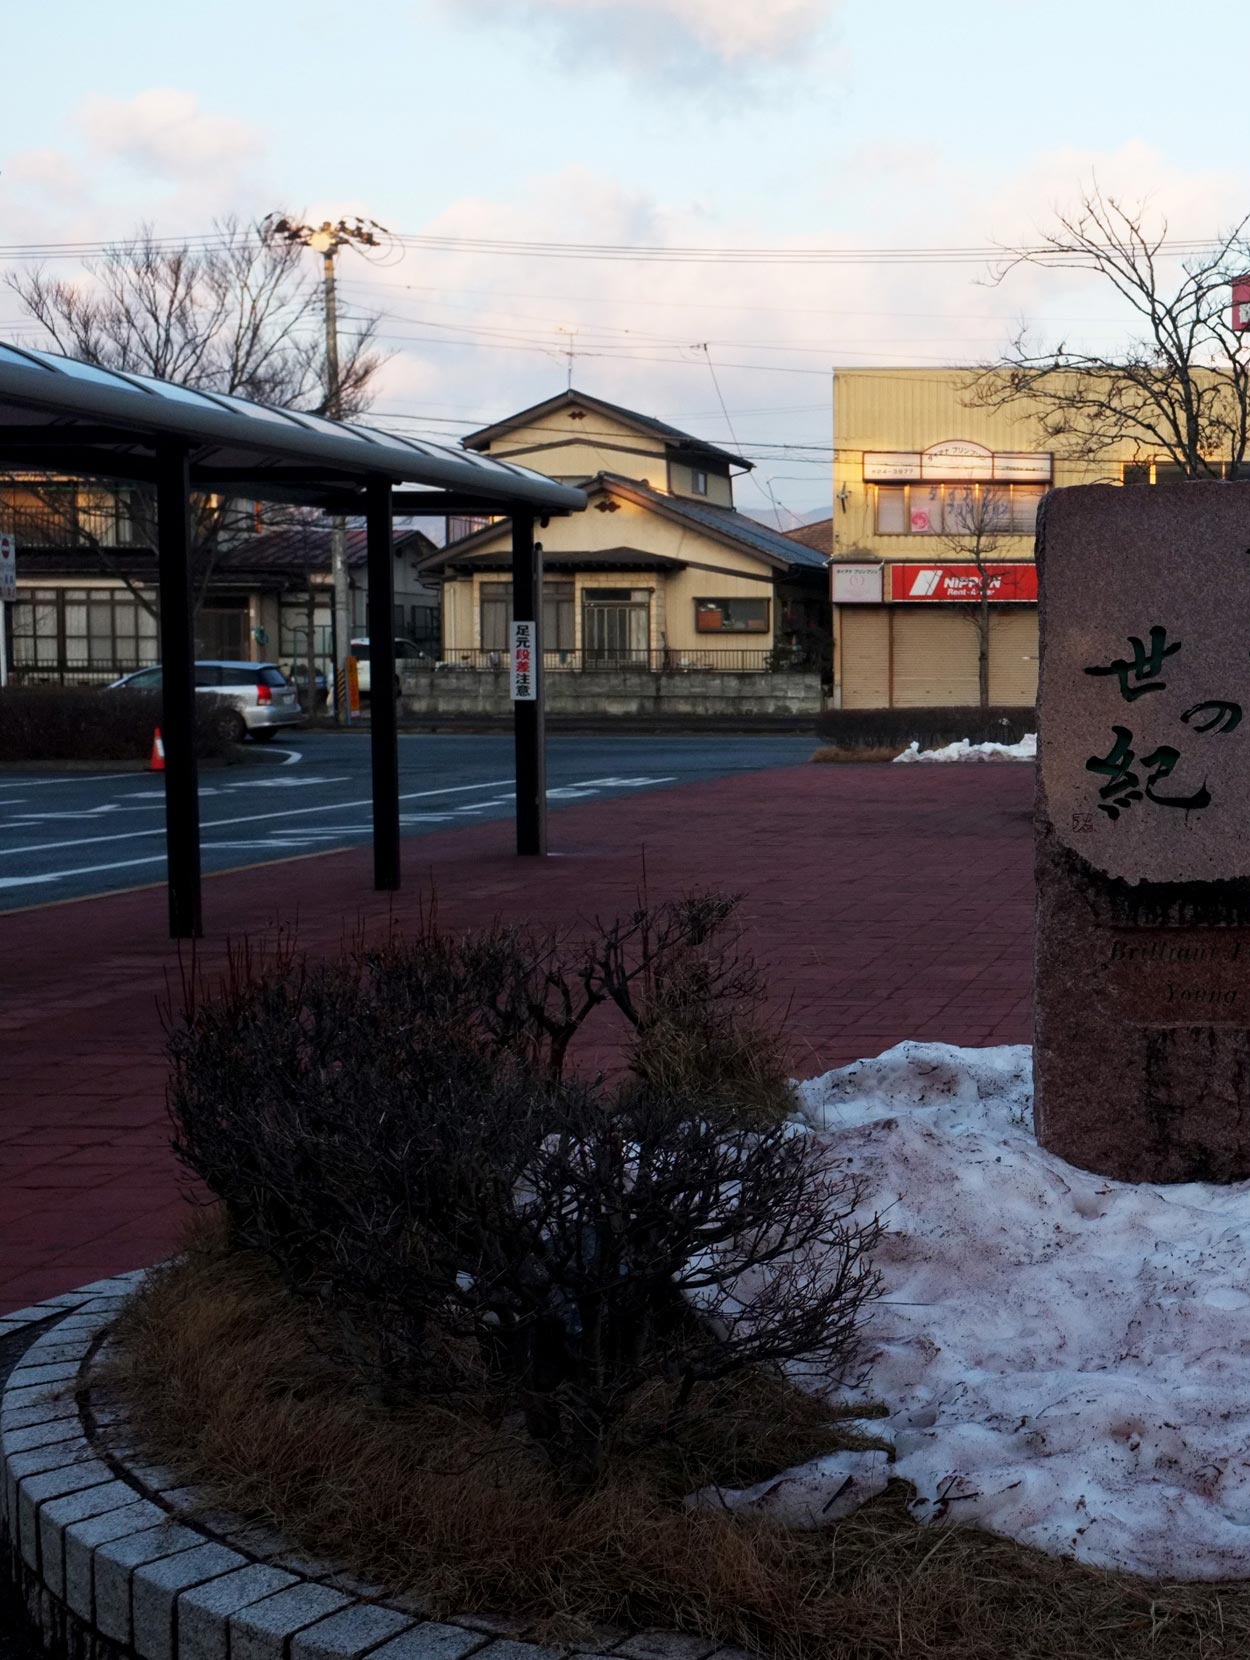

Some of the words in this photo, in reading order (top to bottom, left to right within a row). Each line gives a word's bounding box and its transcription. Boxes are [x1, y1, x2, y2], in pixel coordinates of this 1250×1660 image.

[515, 624, 531, 697] 足元段差注意
[1166, 982, 1238, 1006] Young
